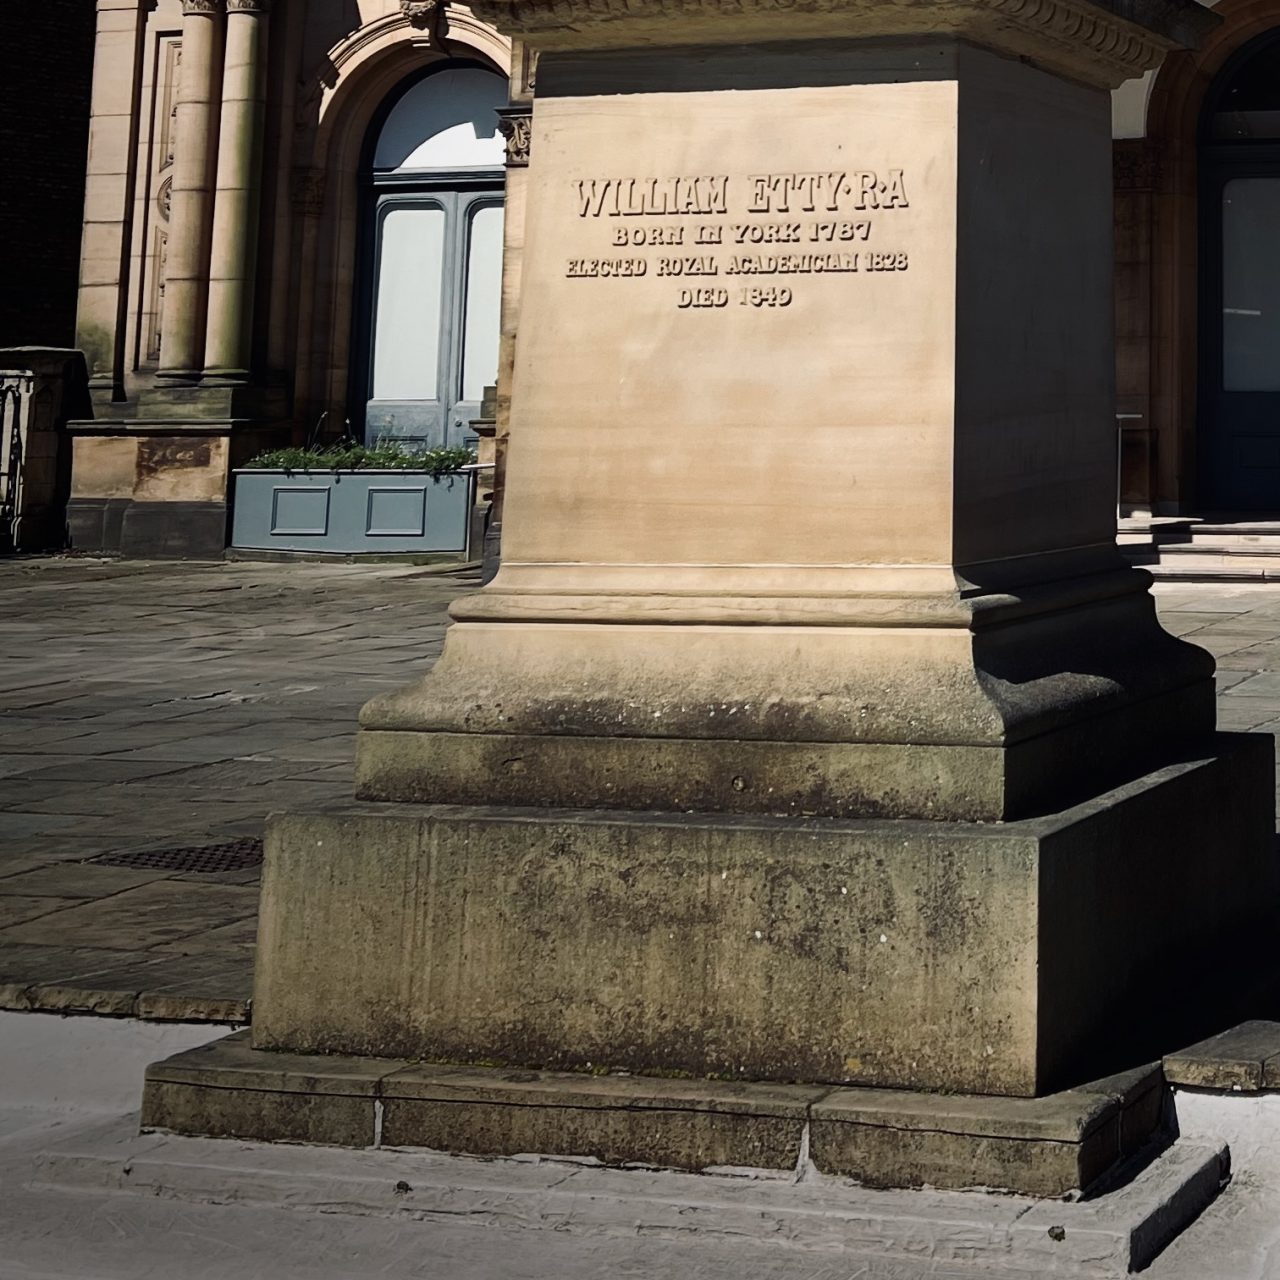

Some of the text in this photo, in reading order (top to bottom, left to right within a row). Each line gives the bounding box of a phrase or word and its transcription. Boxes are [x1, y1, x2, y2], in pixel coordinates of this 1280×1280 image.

[573, 175, 730, 218] WILLIAM
[612, 220, 872, 246] BORN IN YORK 1787
[565, 258, 648, 277] ELECTED
[656, 256, 720, 276] ROYAL
[724, 252, 858, 275] ACADEMICIAN
[677, 286, 730, 308] DIED
